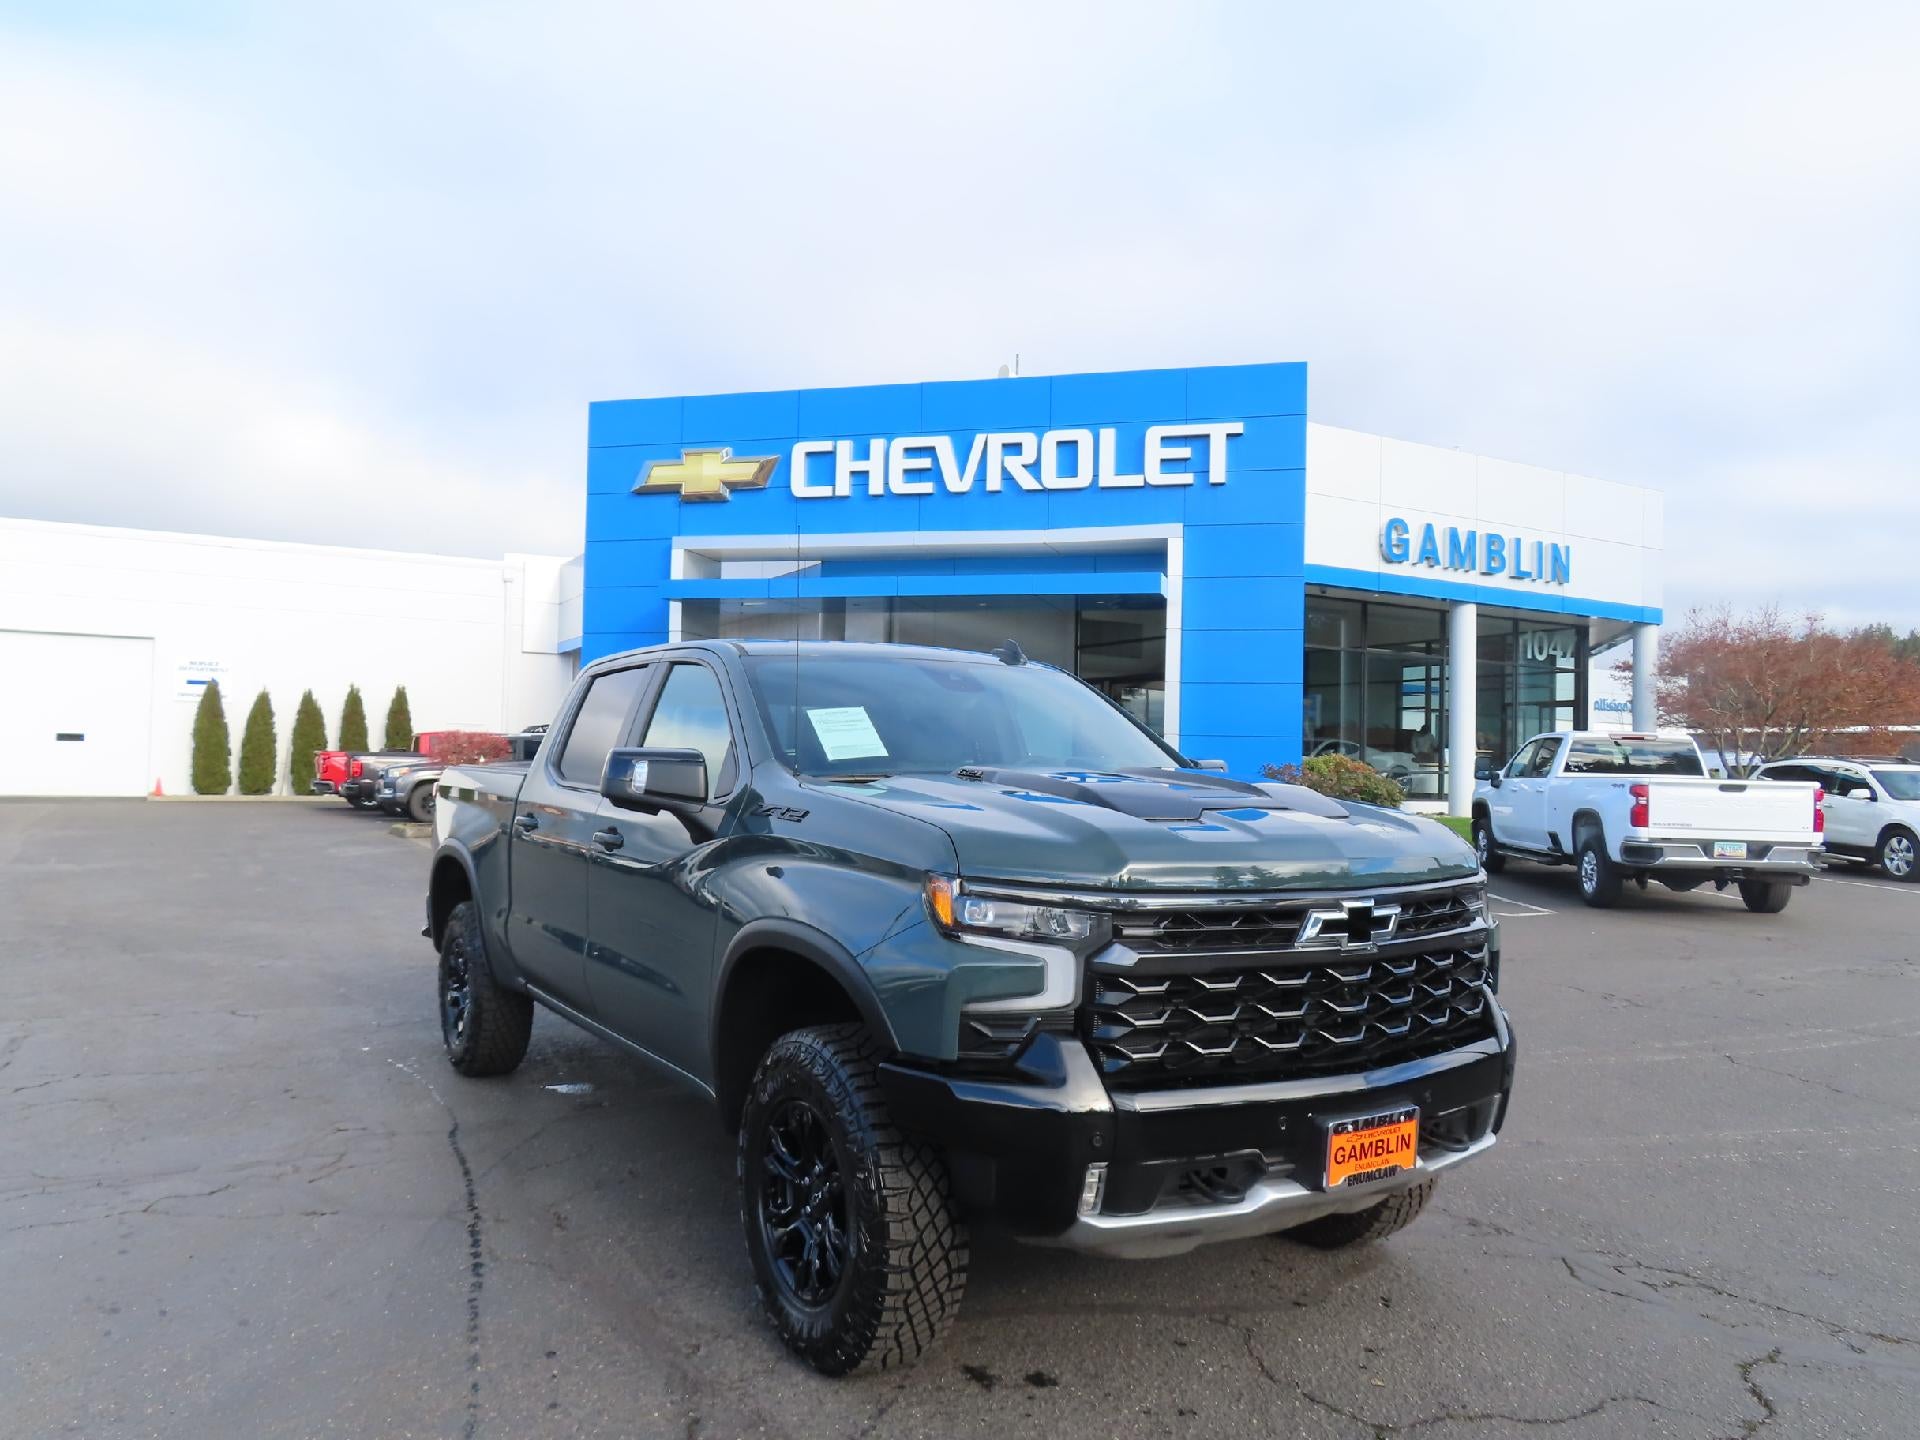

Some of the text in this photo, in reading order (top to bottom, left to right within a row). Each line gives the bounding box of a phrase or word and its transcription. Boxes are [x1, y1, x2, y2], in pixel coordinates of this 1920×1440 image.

[790, 422, 1244, 498] CHEVROLET
[1380, 517, 1570, 585] GAMBLIN
[1333, 1133, 1411, 1165] GAMBLIN
[1347, 1164, 1398, 1187] ENUMCLAW
